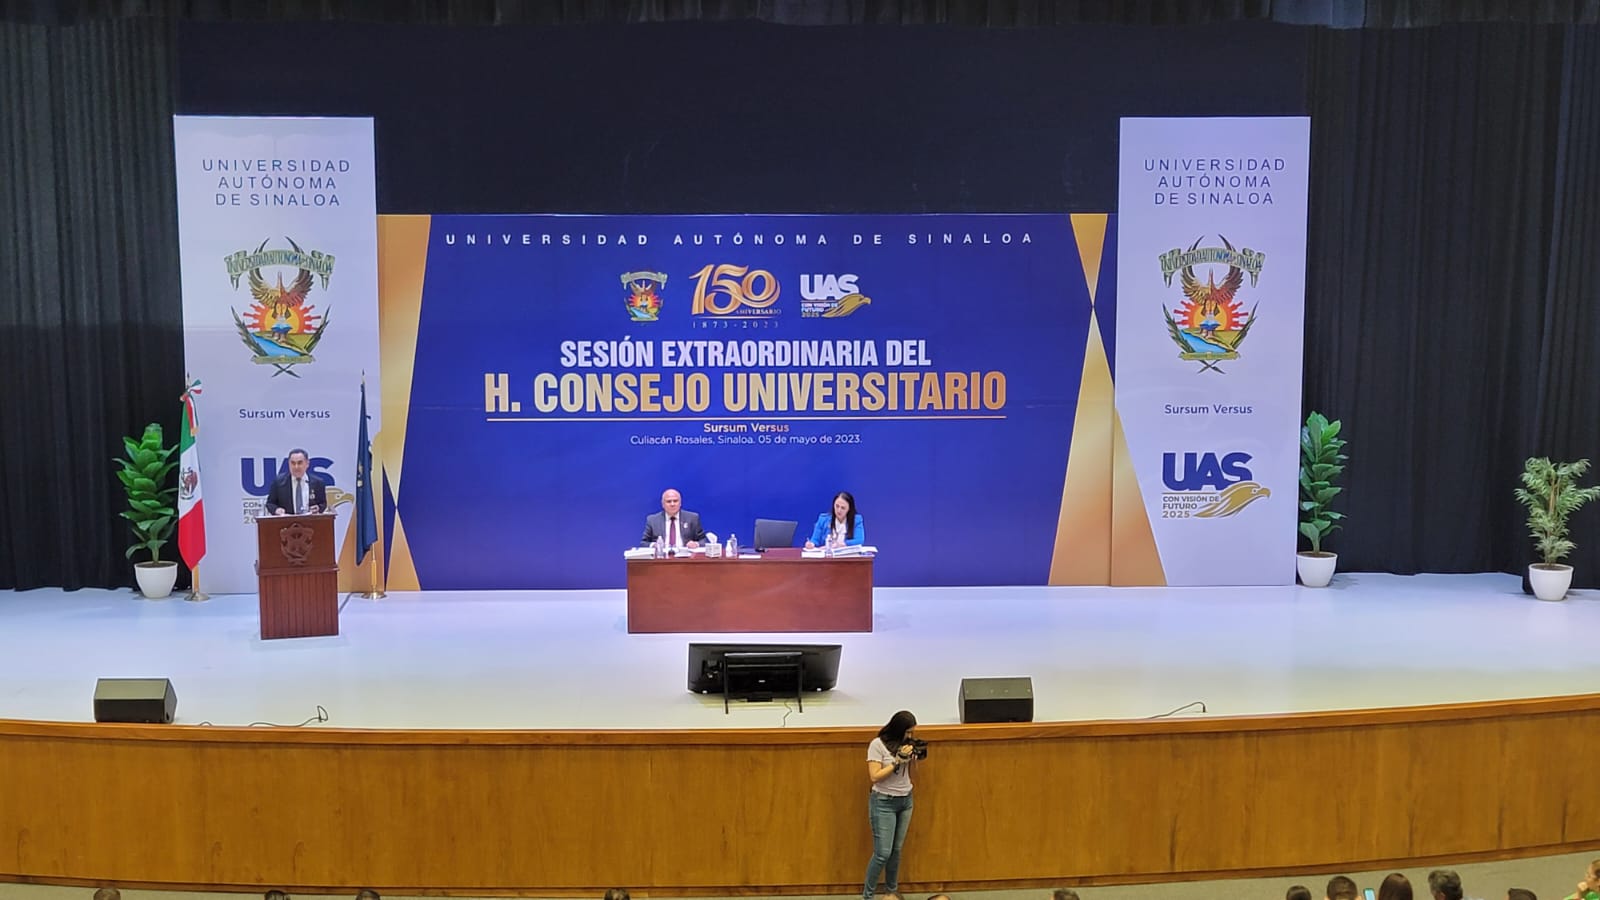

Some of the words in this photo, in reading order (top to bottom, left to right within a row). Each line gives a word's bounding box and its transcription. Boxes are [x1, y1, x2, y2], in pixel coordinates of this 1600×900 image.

[202, 159, 350, 172] UNIVERSIDAD
[1144, 158, 1286, 171] UNIVERSIDAD
[218, 174, 336, 189] AUTÓNOMA
[1158, 173, 1271, 188] AUTÓNOMA
[215, 193, 241, 206] DE
[249, 193, 340, 206] SINALOA
[1154, 192, 1179, 205] DE
[1187, 192, 1273, 205] SINALOA
[446, 234, 648, 245] UNIVERSIDAD
[673, 232, 827, 245] AUTÓNOMA
[853, 234, 882, 245] DE
[908, 233, 1031, 244] SINALOA
[688, 264, 781, 315] 150
[800, 274, 860, 301] UAS
[560, 335, 653, 368] SESIÓN
[662, 340, 879, 367] EXTRAORDINARIA
[886, 340, 931, 366] DEL
[484, 373, 521, 413] H.
[534, 372, 710, 413] CONSEJO
[723, 371, 1007, 412] UNIVERSITARIO
[239, 408, 285, 419] Sursum
[290, 408, 331, 419] Versus
[1164, 404, 1209, 414] Sursum
[1213, 404, 1253, 414] Versus
[703, 423, 747, 433] Sursum
[750, 423, 789, 433] Versus
[630, 435, 672, 445] Culiacán
[675, 435, 715, 446] Rosales,
[758, 435, 772, 444] 05
[774, 435, 787, 444] de
[789, 437, 817, 446] mayo
[819, 435, 832, 444] de
[835, 434, 863, 444] 2023.
[241, 457, 336, 497] US
[1162, 452, 1253, 491] UAS
[1162, 510, 1190, 518] 2025
